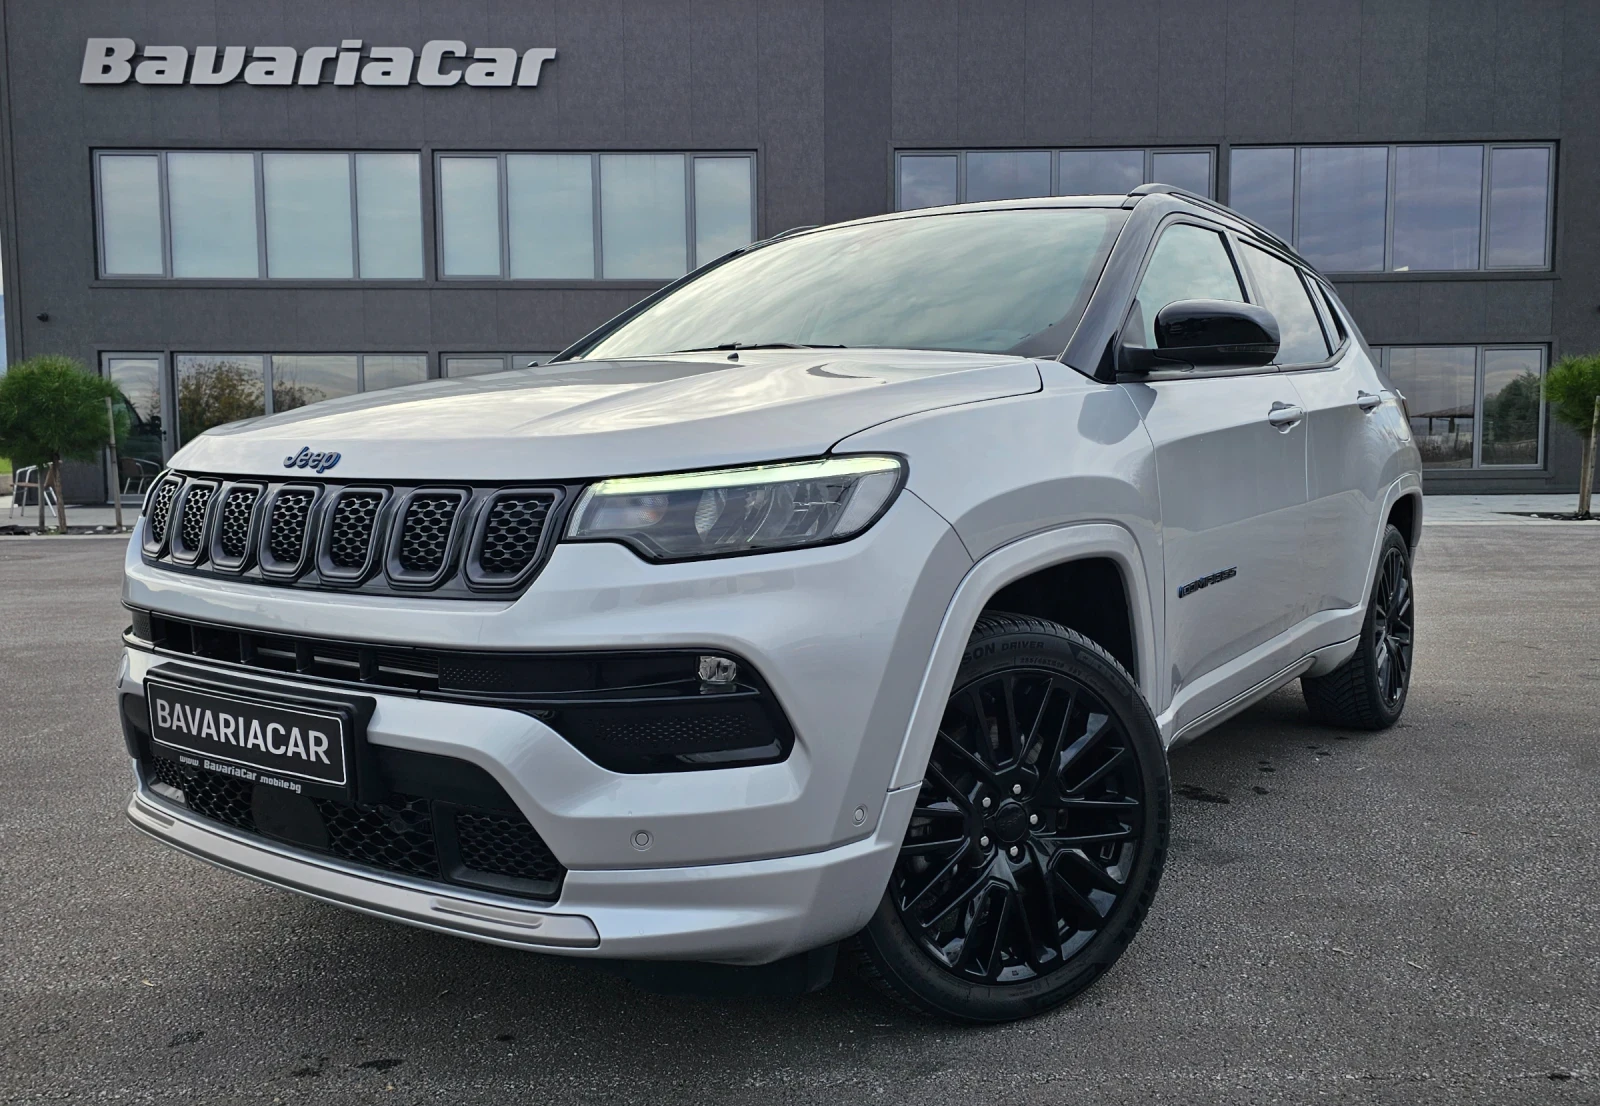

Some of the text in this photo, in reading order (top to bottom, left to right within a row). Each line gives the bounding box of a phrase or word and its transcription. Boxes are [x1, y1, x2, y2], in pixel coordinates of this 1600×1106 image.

[80, 37, 557, 86] BavariaCar
[283, 446, 341, 474] Jeep
[1002, 641, 1045, 652] DRIVER
[156, 699, 331, 764] BAVARIACAR
[203, 759, 257, 781] BavariaCar
